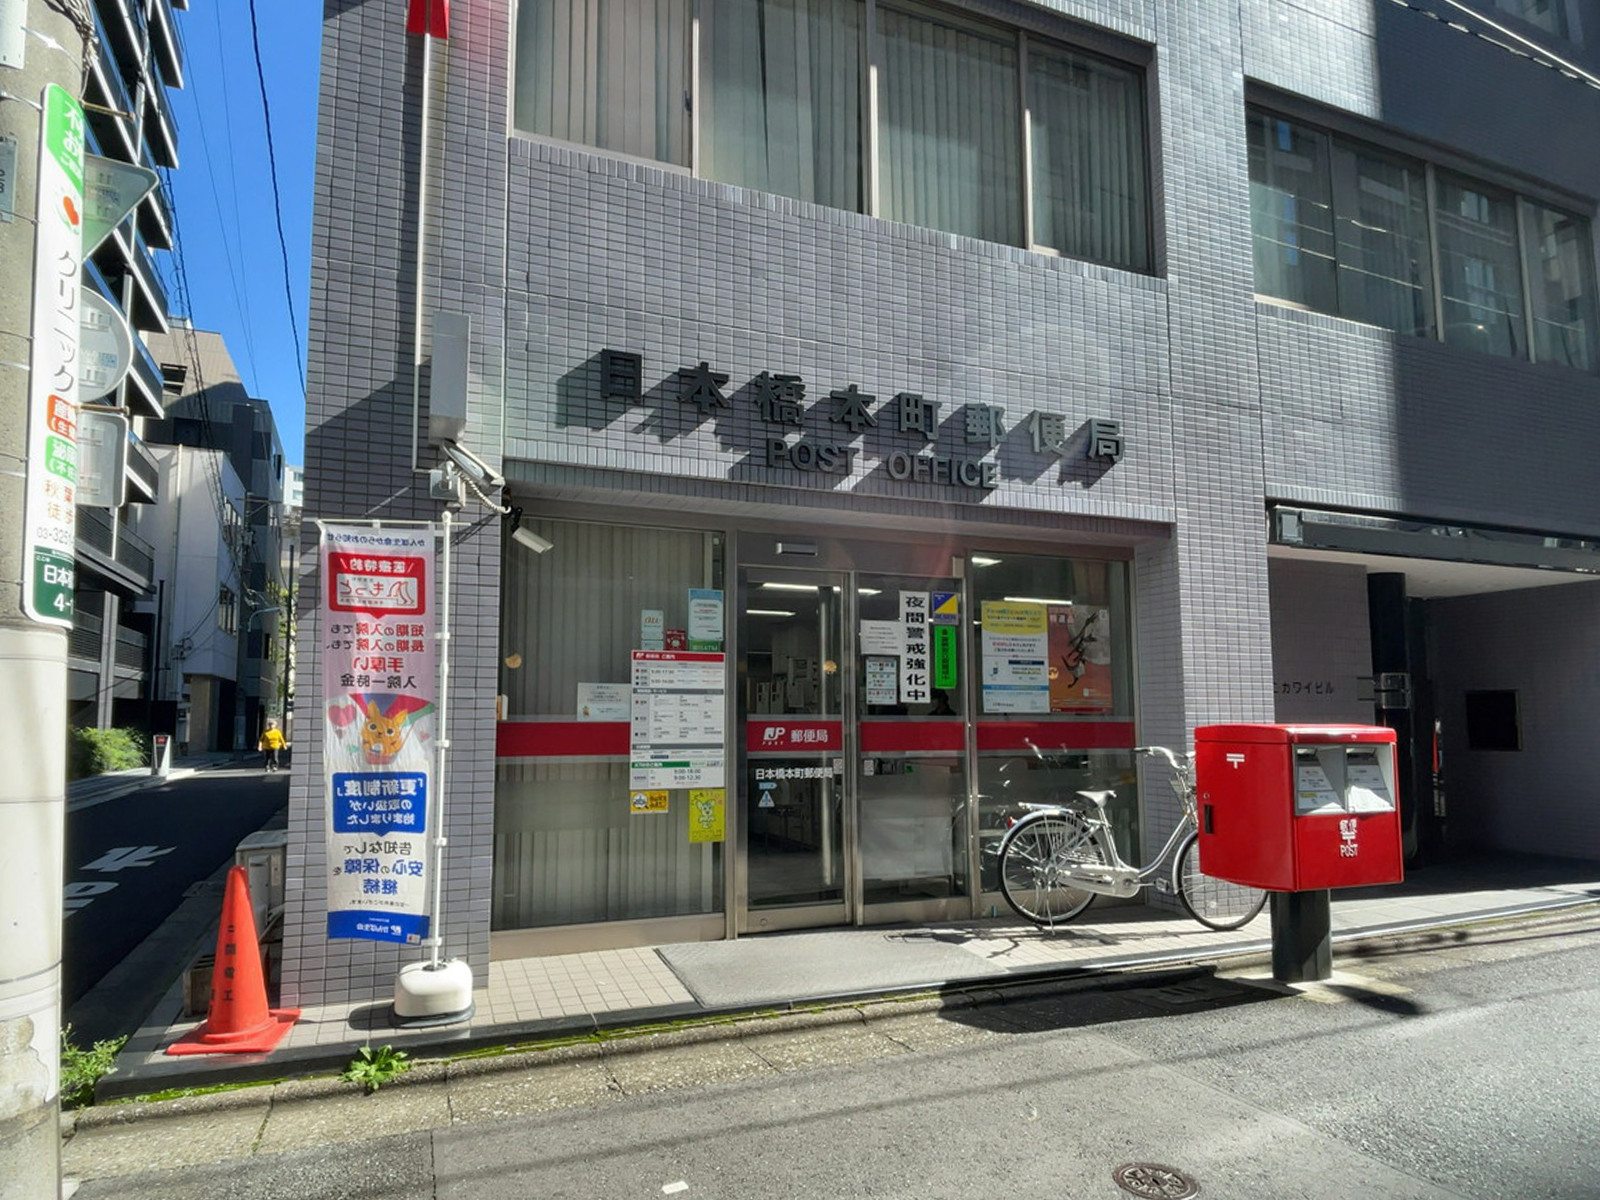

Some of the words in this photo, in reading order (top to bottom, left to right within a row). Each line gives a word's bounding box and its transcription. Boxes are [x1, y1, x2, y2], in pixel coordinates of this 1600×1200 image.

[599, 348, 1123, 461] 日本橋本町郵便局
[767, 437, 860, 474] POST
[888, 449, 999, 489] OFFICE
[905, 596, 926, 701] 夜間警戒強化中
[791, 729, 828, 743] 郵便局
[755, 767, 833, 780] 日本橋本町郵便局
[1340, 844, 1358, 858] POST
